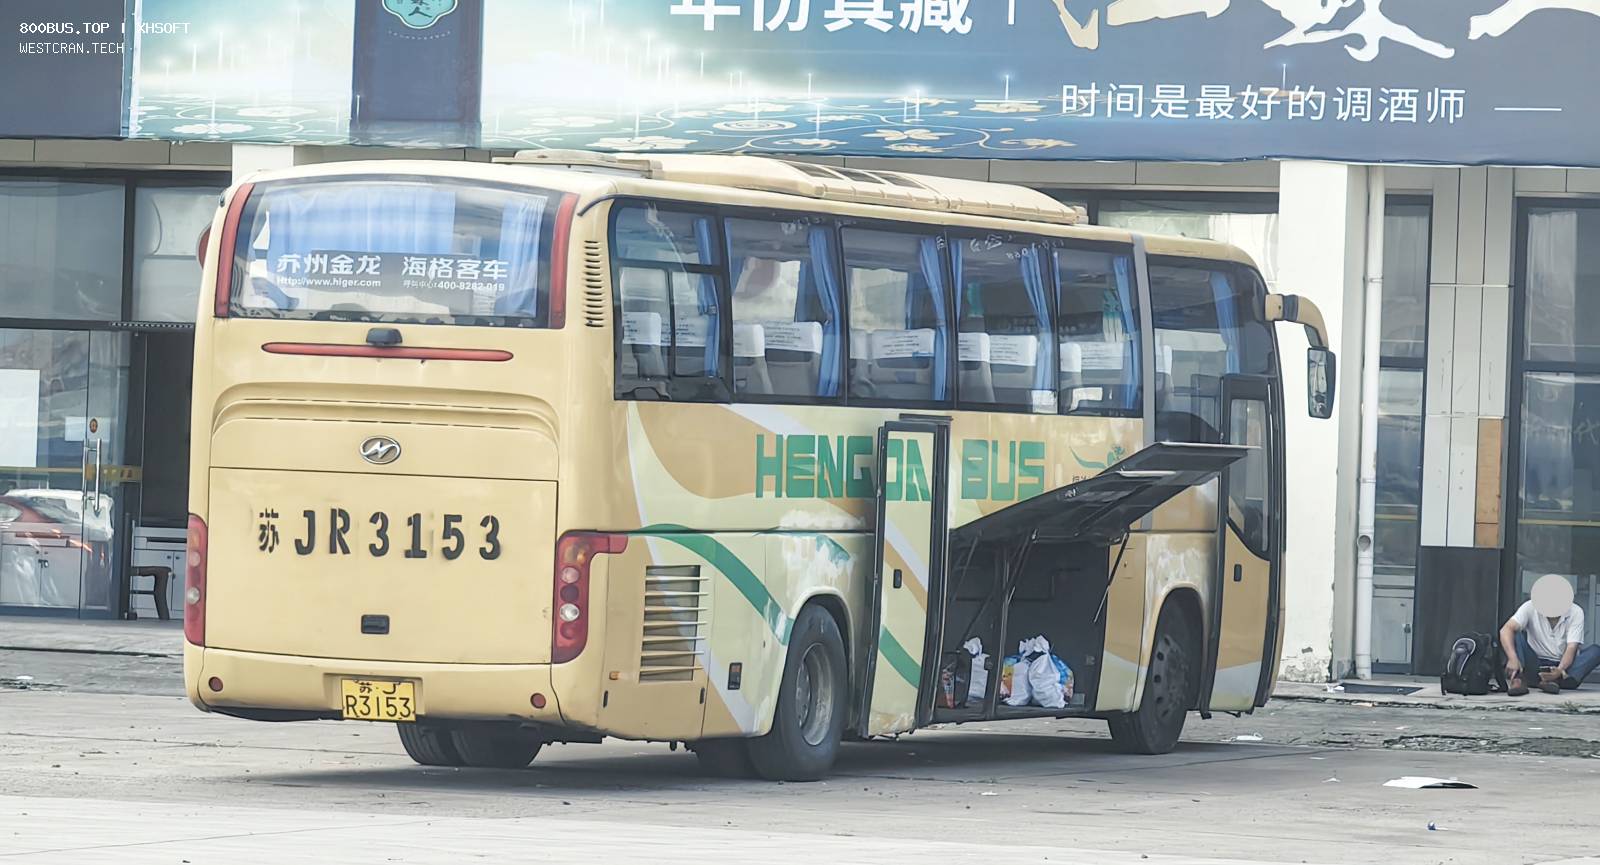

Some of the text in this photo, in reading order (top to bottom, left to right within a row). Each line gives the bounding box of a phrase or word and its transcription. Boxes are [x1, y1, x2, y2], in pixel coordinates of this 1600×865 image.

[1061, 82, 1466, 124] 时间是最好的调酒师
[277, 253, 511, 280] 苏州金龙 海格客车
[961, 439, 1045, 502] BUS
[345, 695, 411, 718] R3153
